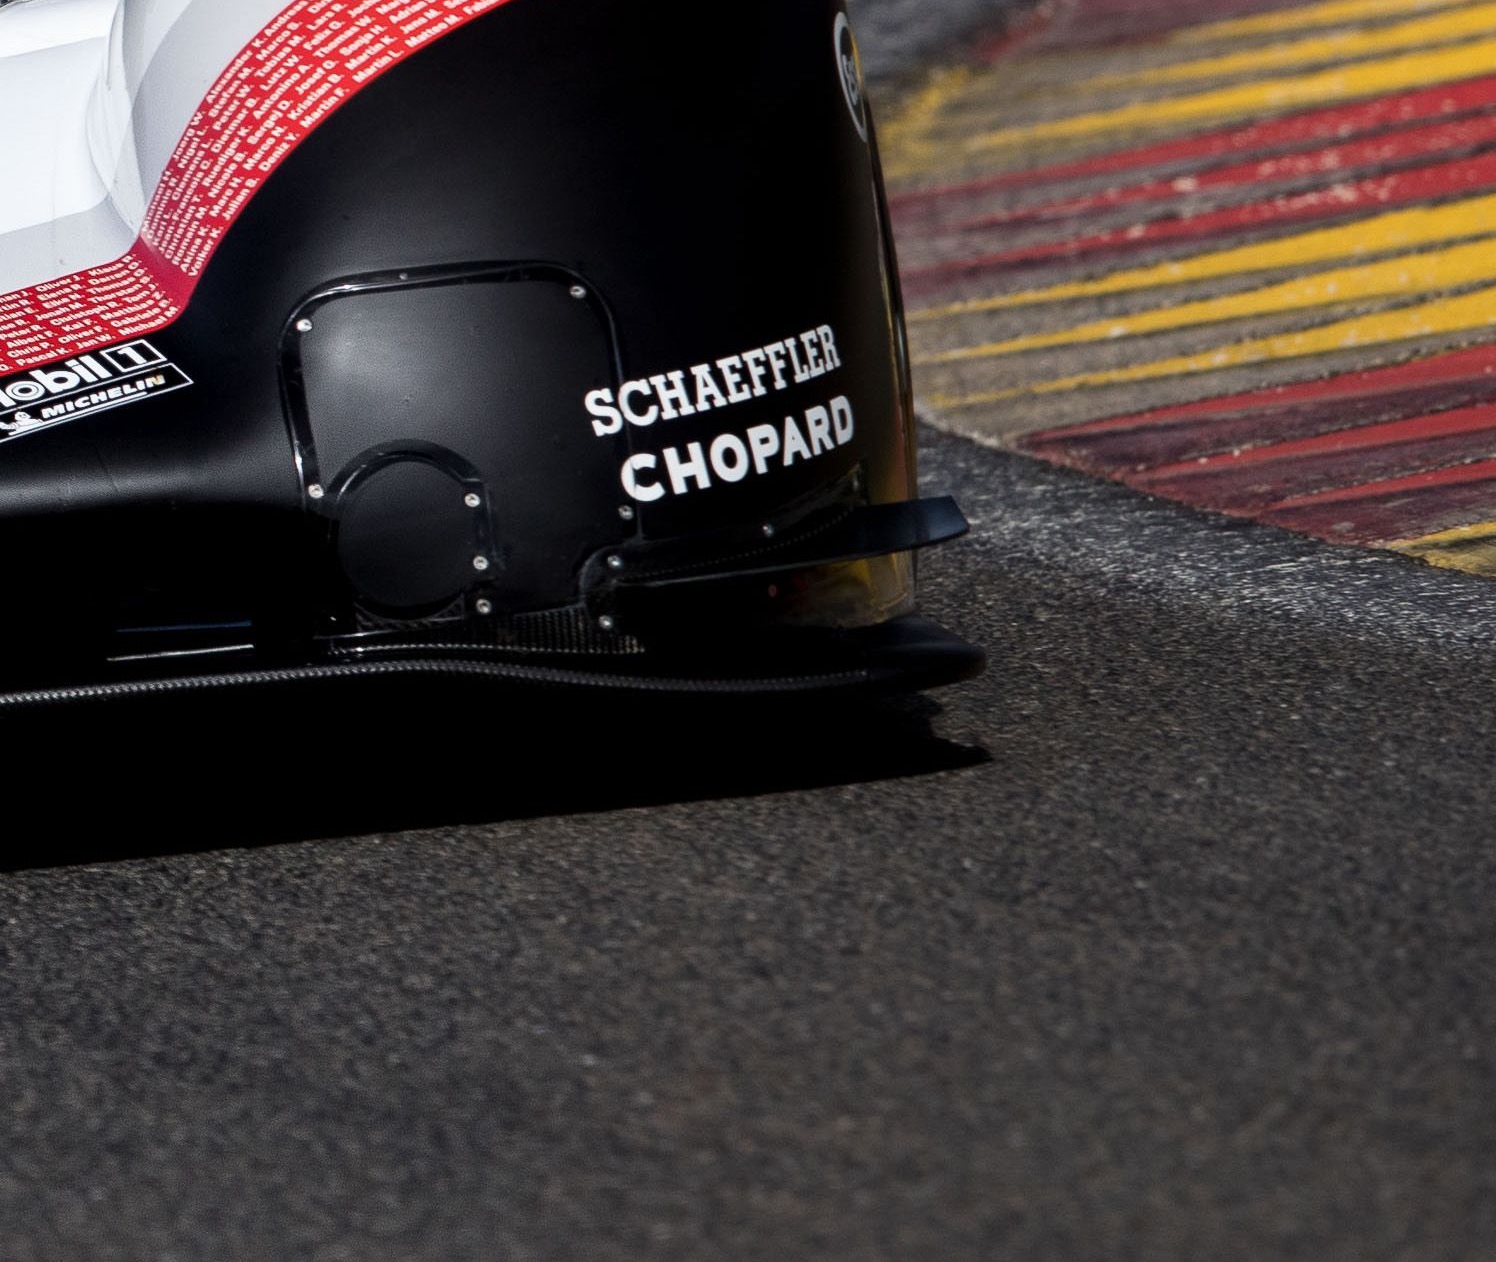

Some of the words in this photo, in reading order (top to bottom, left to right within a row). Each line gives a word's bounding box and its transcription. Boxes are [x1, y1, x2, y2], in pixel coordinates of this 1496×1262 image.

[41, 375, 166, 420] MICHELIN
[584, 324, 841, 437] SCHAEFFLER
[621, 395, 853, 502] CHOPARD
